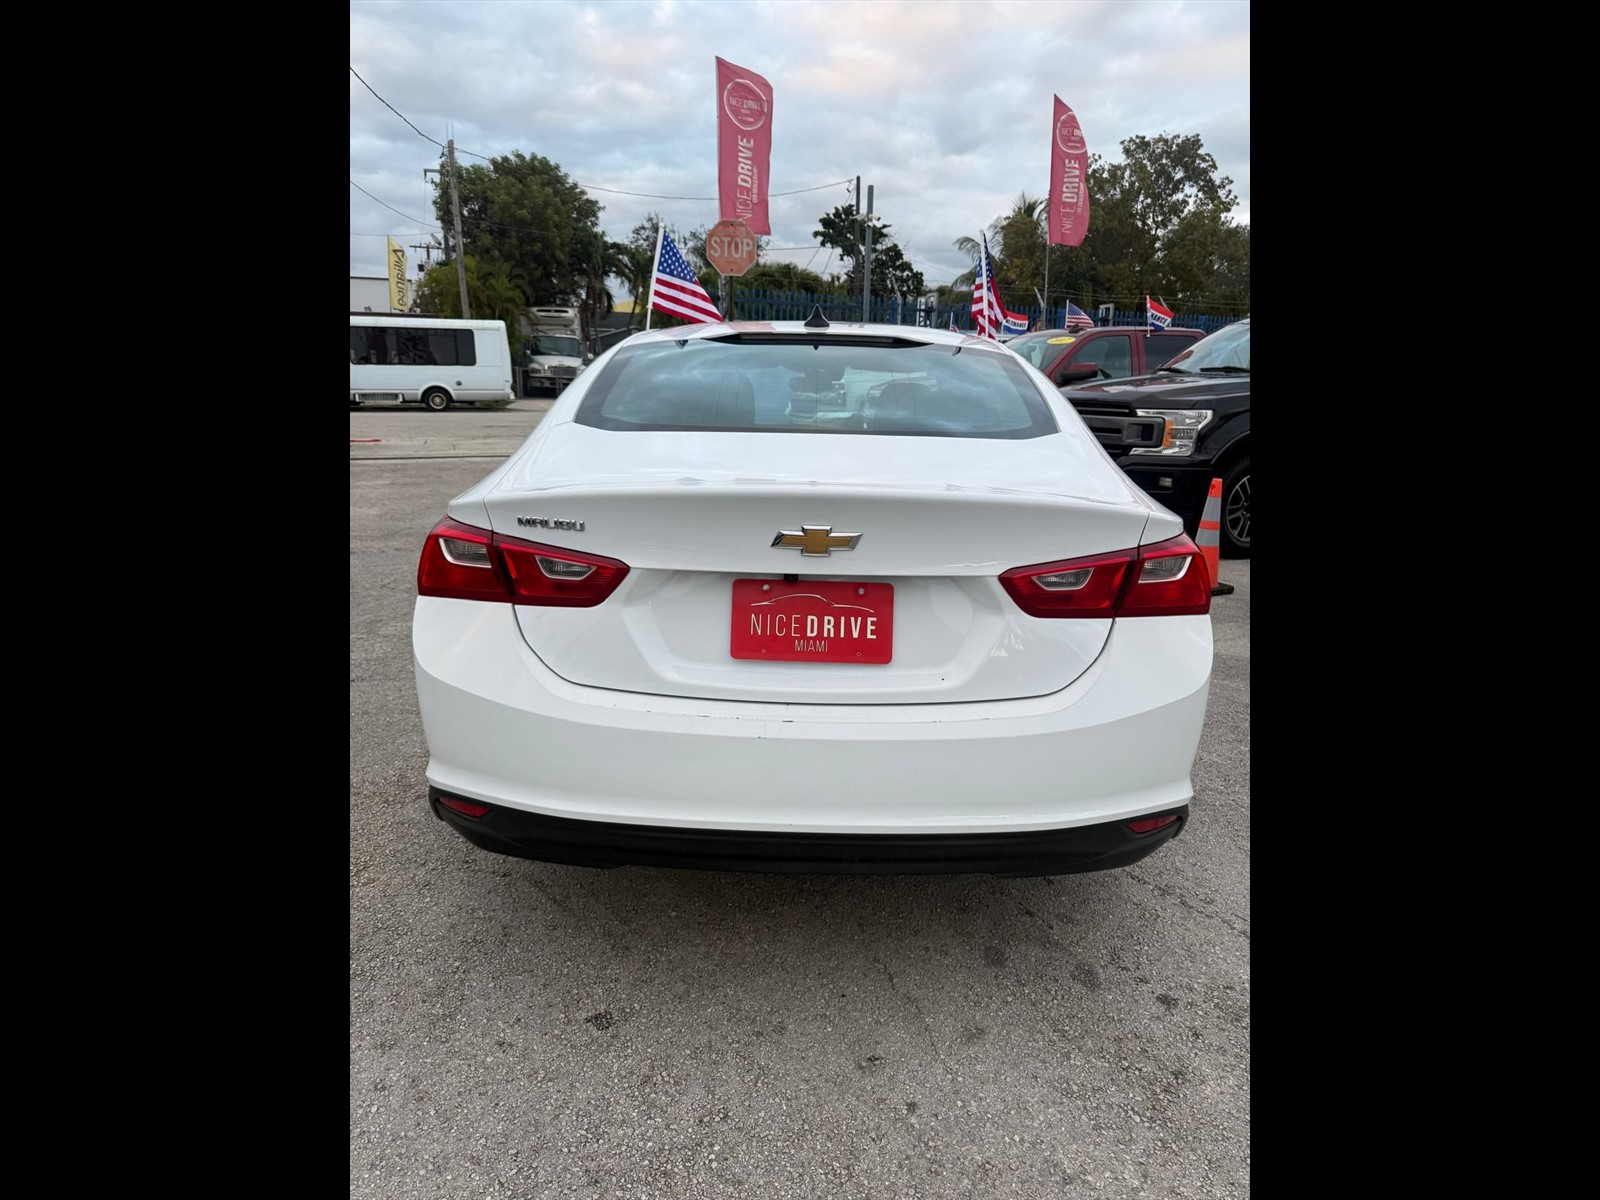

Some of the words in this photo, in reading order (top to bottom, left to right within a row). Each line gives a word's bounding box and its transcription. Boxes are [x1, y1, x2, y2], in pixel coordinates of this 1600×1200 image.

[737, 134, 755, 188] DRIVE
[1062, 159, 1079, 203] DRIVE
[736, 189, 753, 221] NICE
[1060, 204, 1076, 233] NICE
[710, 236, 753, 258] STOP
[517, 515, 585, 532] MALIBU
[794, 639, 828, 653] MIAMI
